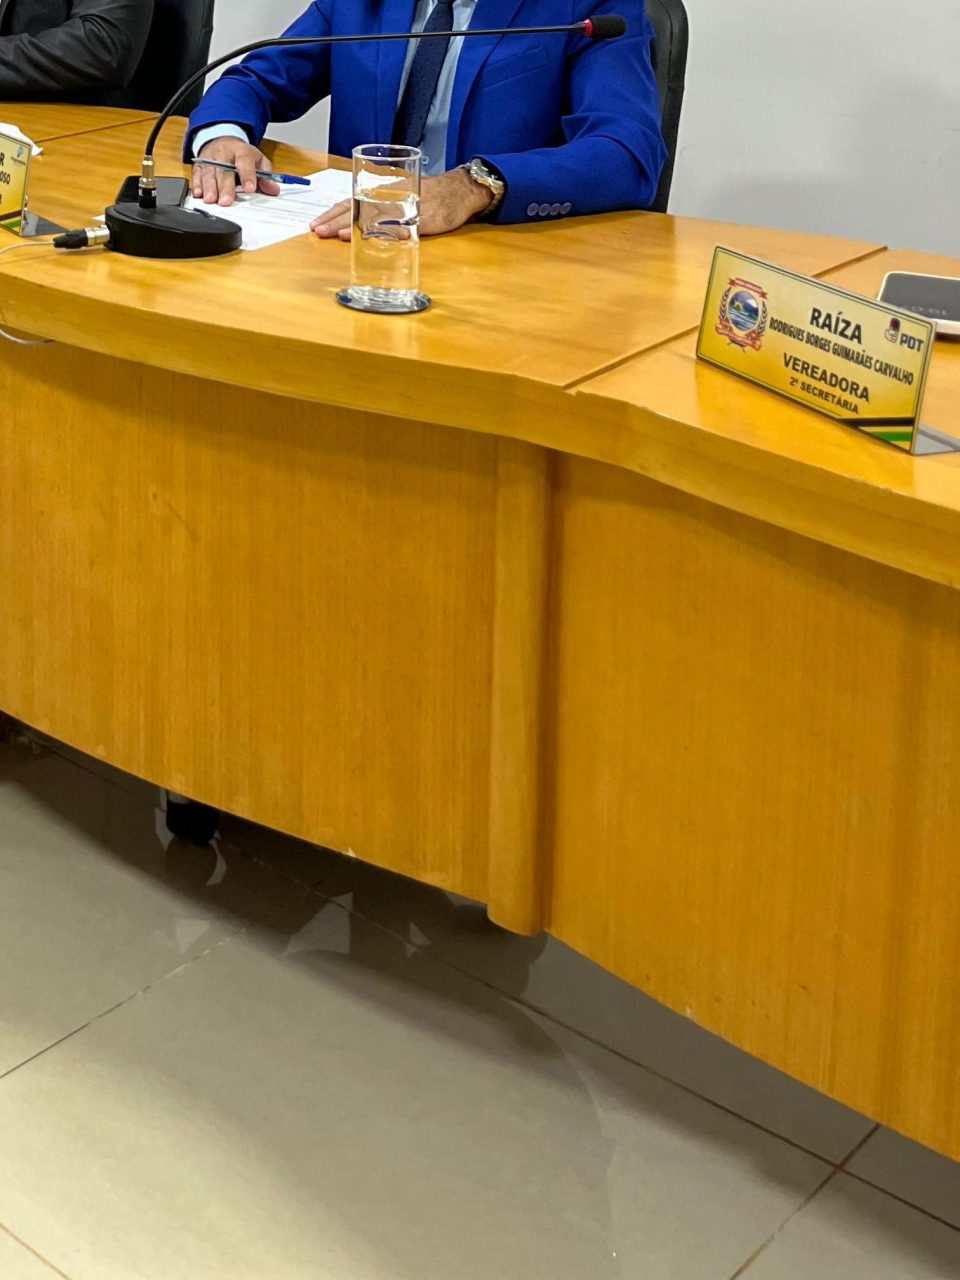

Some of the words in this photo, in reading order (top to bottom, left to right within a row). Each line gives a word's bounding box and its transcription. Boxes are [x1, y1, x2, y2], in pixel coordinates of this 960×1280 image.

[809, 307, 862, 345] RAÍZA
[899, 333, 924, 353] PDT
[769, 316, 806, 341] RODRIGUES
[805, 331, 832, 353] BORGES
[832, 342, 873, 370] GUIMARÃES
[874, 358, 914, 386] CARVALHO
[783, 352, 870, 402] VEREADORA
